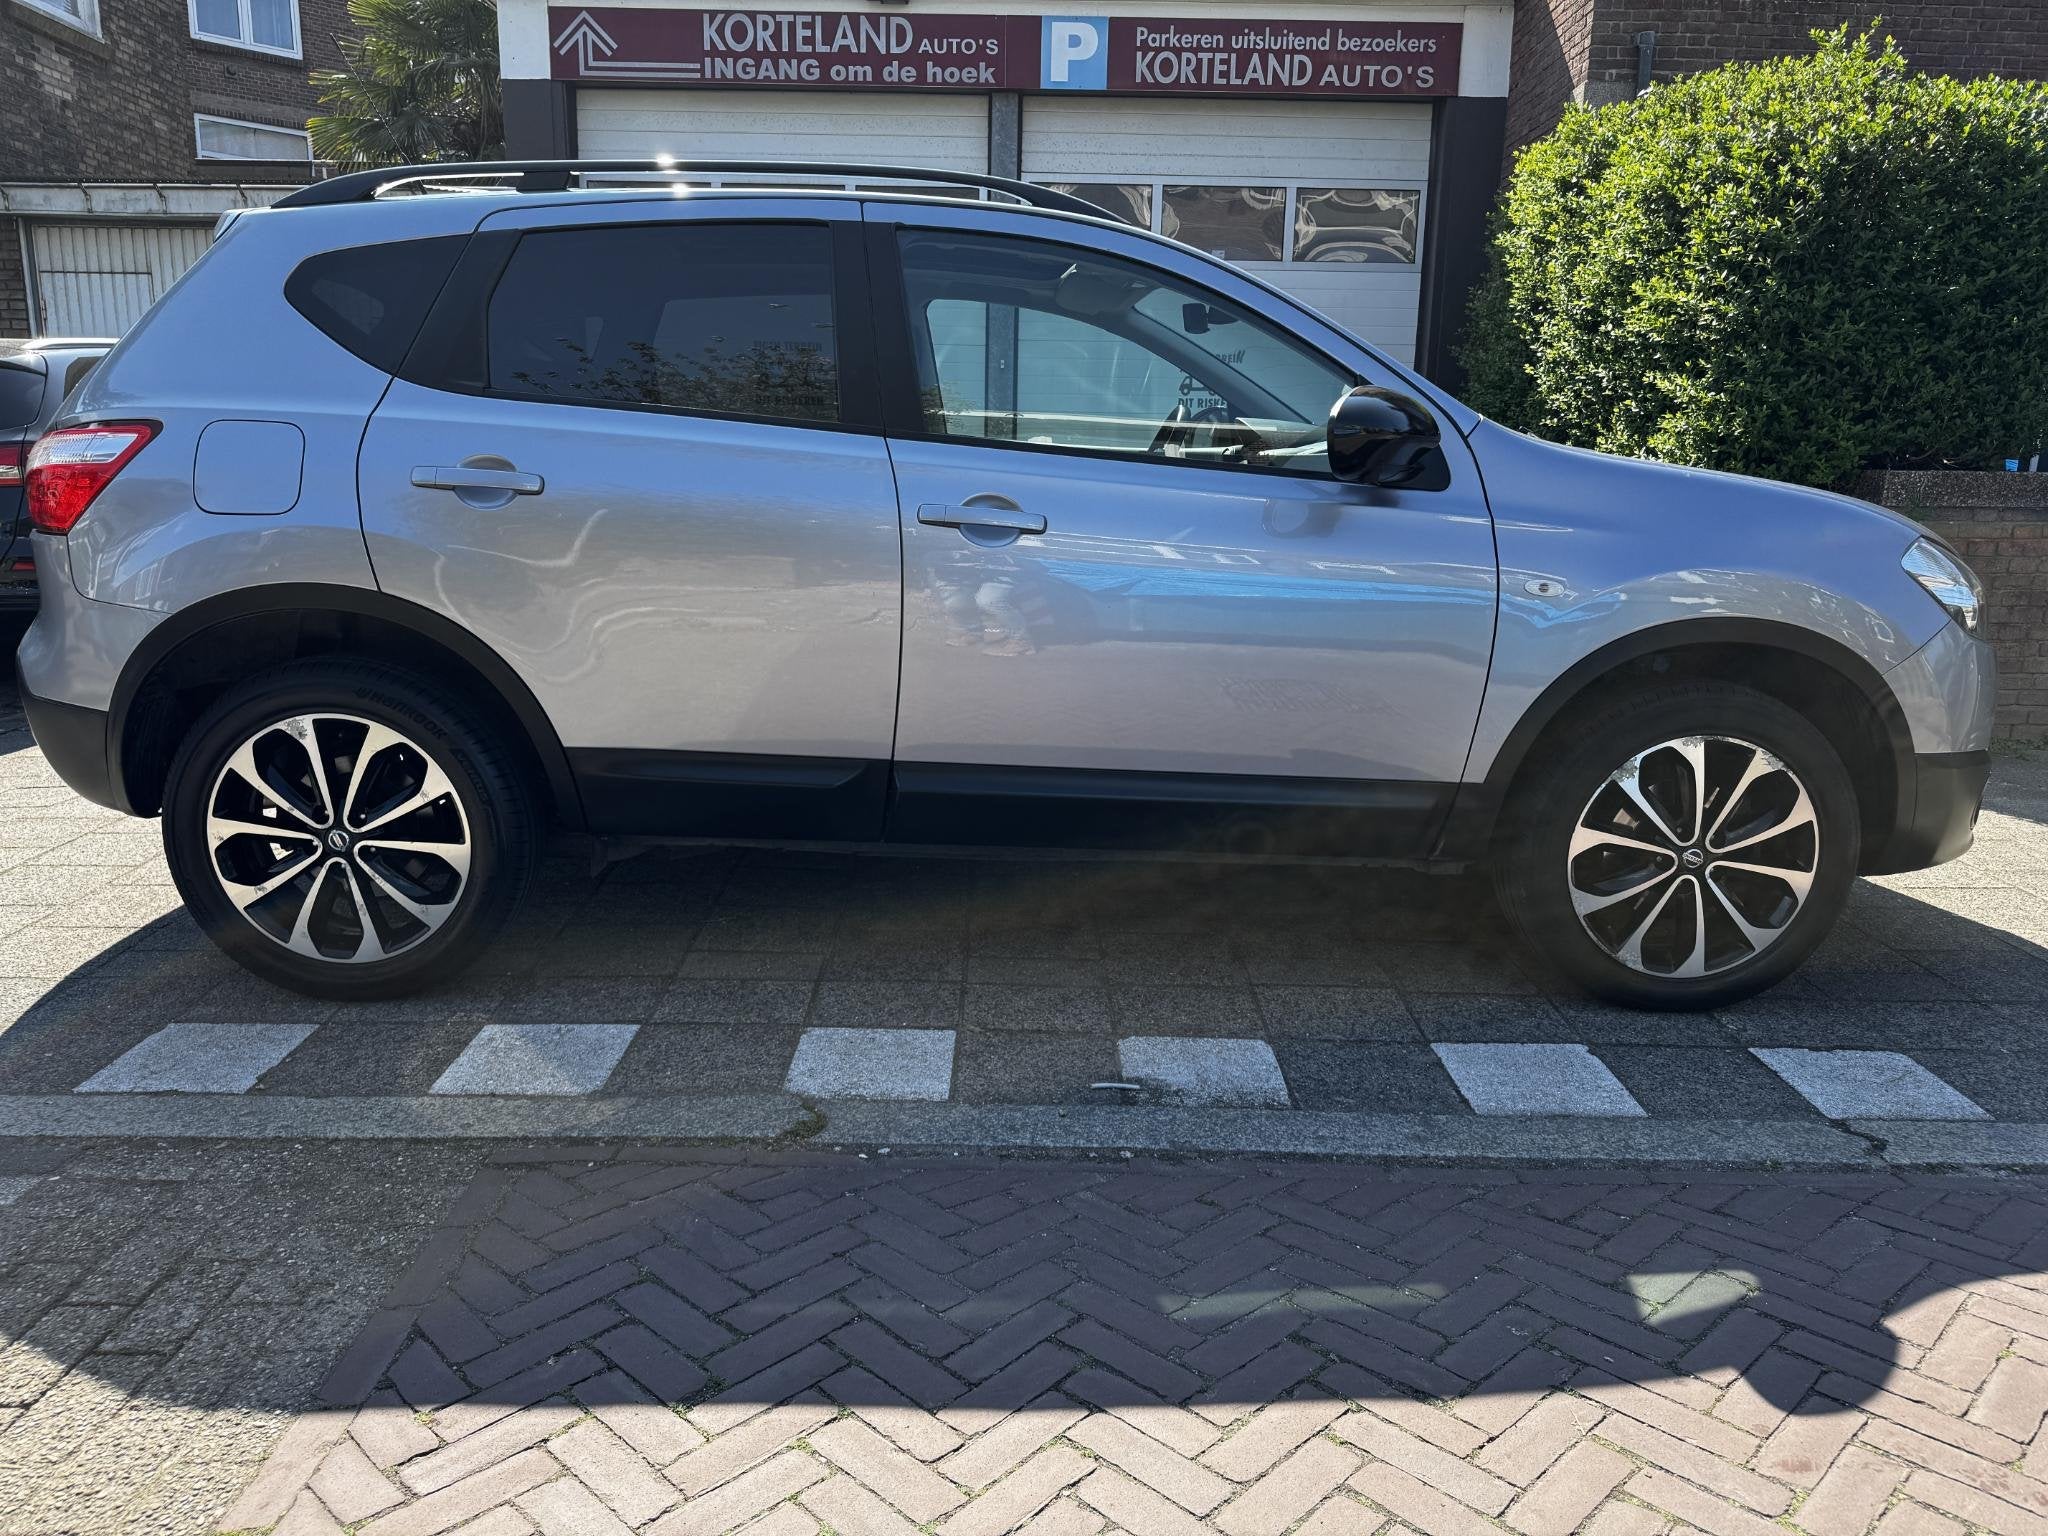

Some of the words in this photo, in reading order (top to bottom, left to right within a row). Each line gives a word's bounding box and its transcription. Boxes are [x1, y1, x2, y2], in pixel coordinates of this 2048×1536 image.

[703, 13, 914, 54] KORTELAND
[918, 38, 999, 55] AUTO'S
[1050, 21, 1098, 82] P
[1136, 26, 1224, 49] Parkeren
[1231, 27, 1331, 51] uitsluitend
[1336, 28, 1437, 53] bezoekers
[704, 57, 820, 81] INGANG
[830, 64, 873, 82] om
[882, 60, 917, 83] de
[926, 61, 996, 84] hoek
[1135, 50, 1313, 86] KORTELAND
[1318, 64, 1434, 88] AUTO'S
